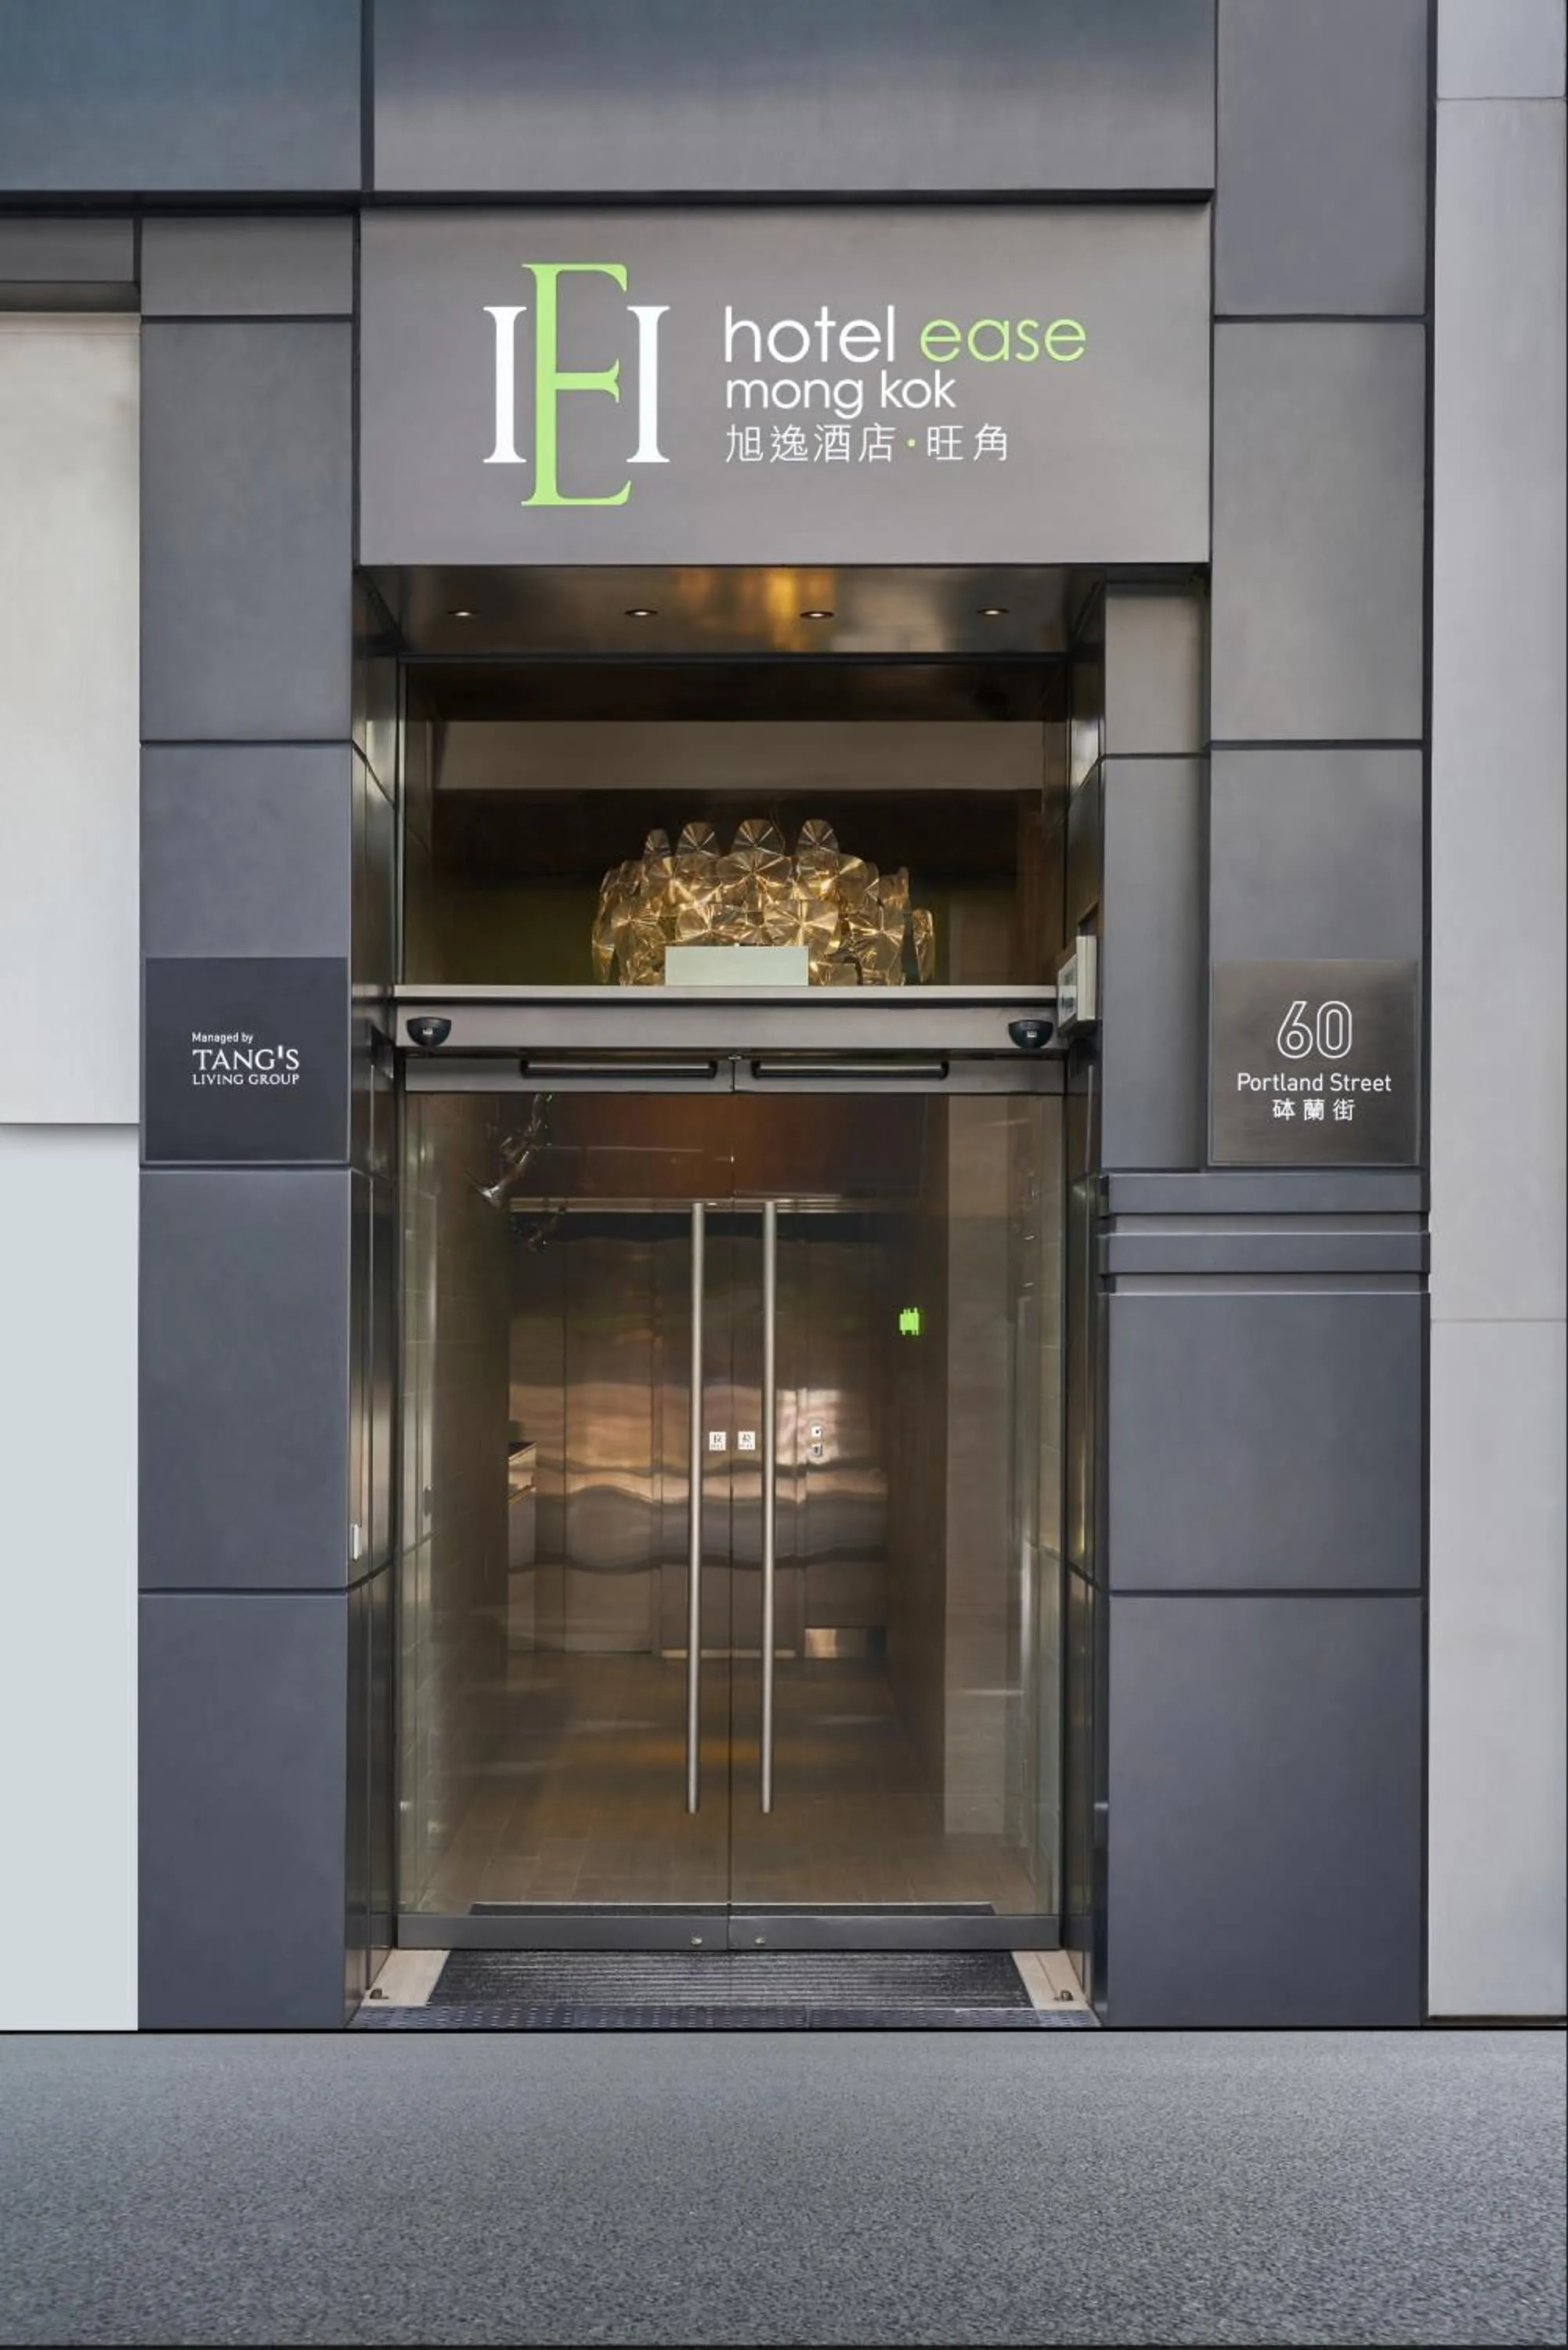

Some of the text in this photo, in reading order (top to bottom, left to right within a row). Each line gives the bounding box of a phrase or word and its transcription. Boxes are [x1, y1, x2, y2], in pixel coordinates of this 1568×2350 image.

[725, 305, 1086, 363] hotel ease
[726, 370, 956, 419] mong kok
[192, 1032, 254, 1044] Managed by
[1277, 1000, 1353, 1058] 60
[192, 1045, 300, 1070] TANG'S
[193, 1074, 300, 1085] LIVING GROUP
[1237, 1072, 1392, 1091] Portland Street
[1272, 1097, 1356, 1121] 砵蘭街
